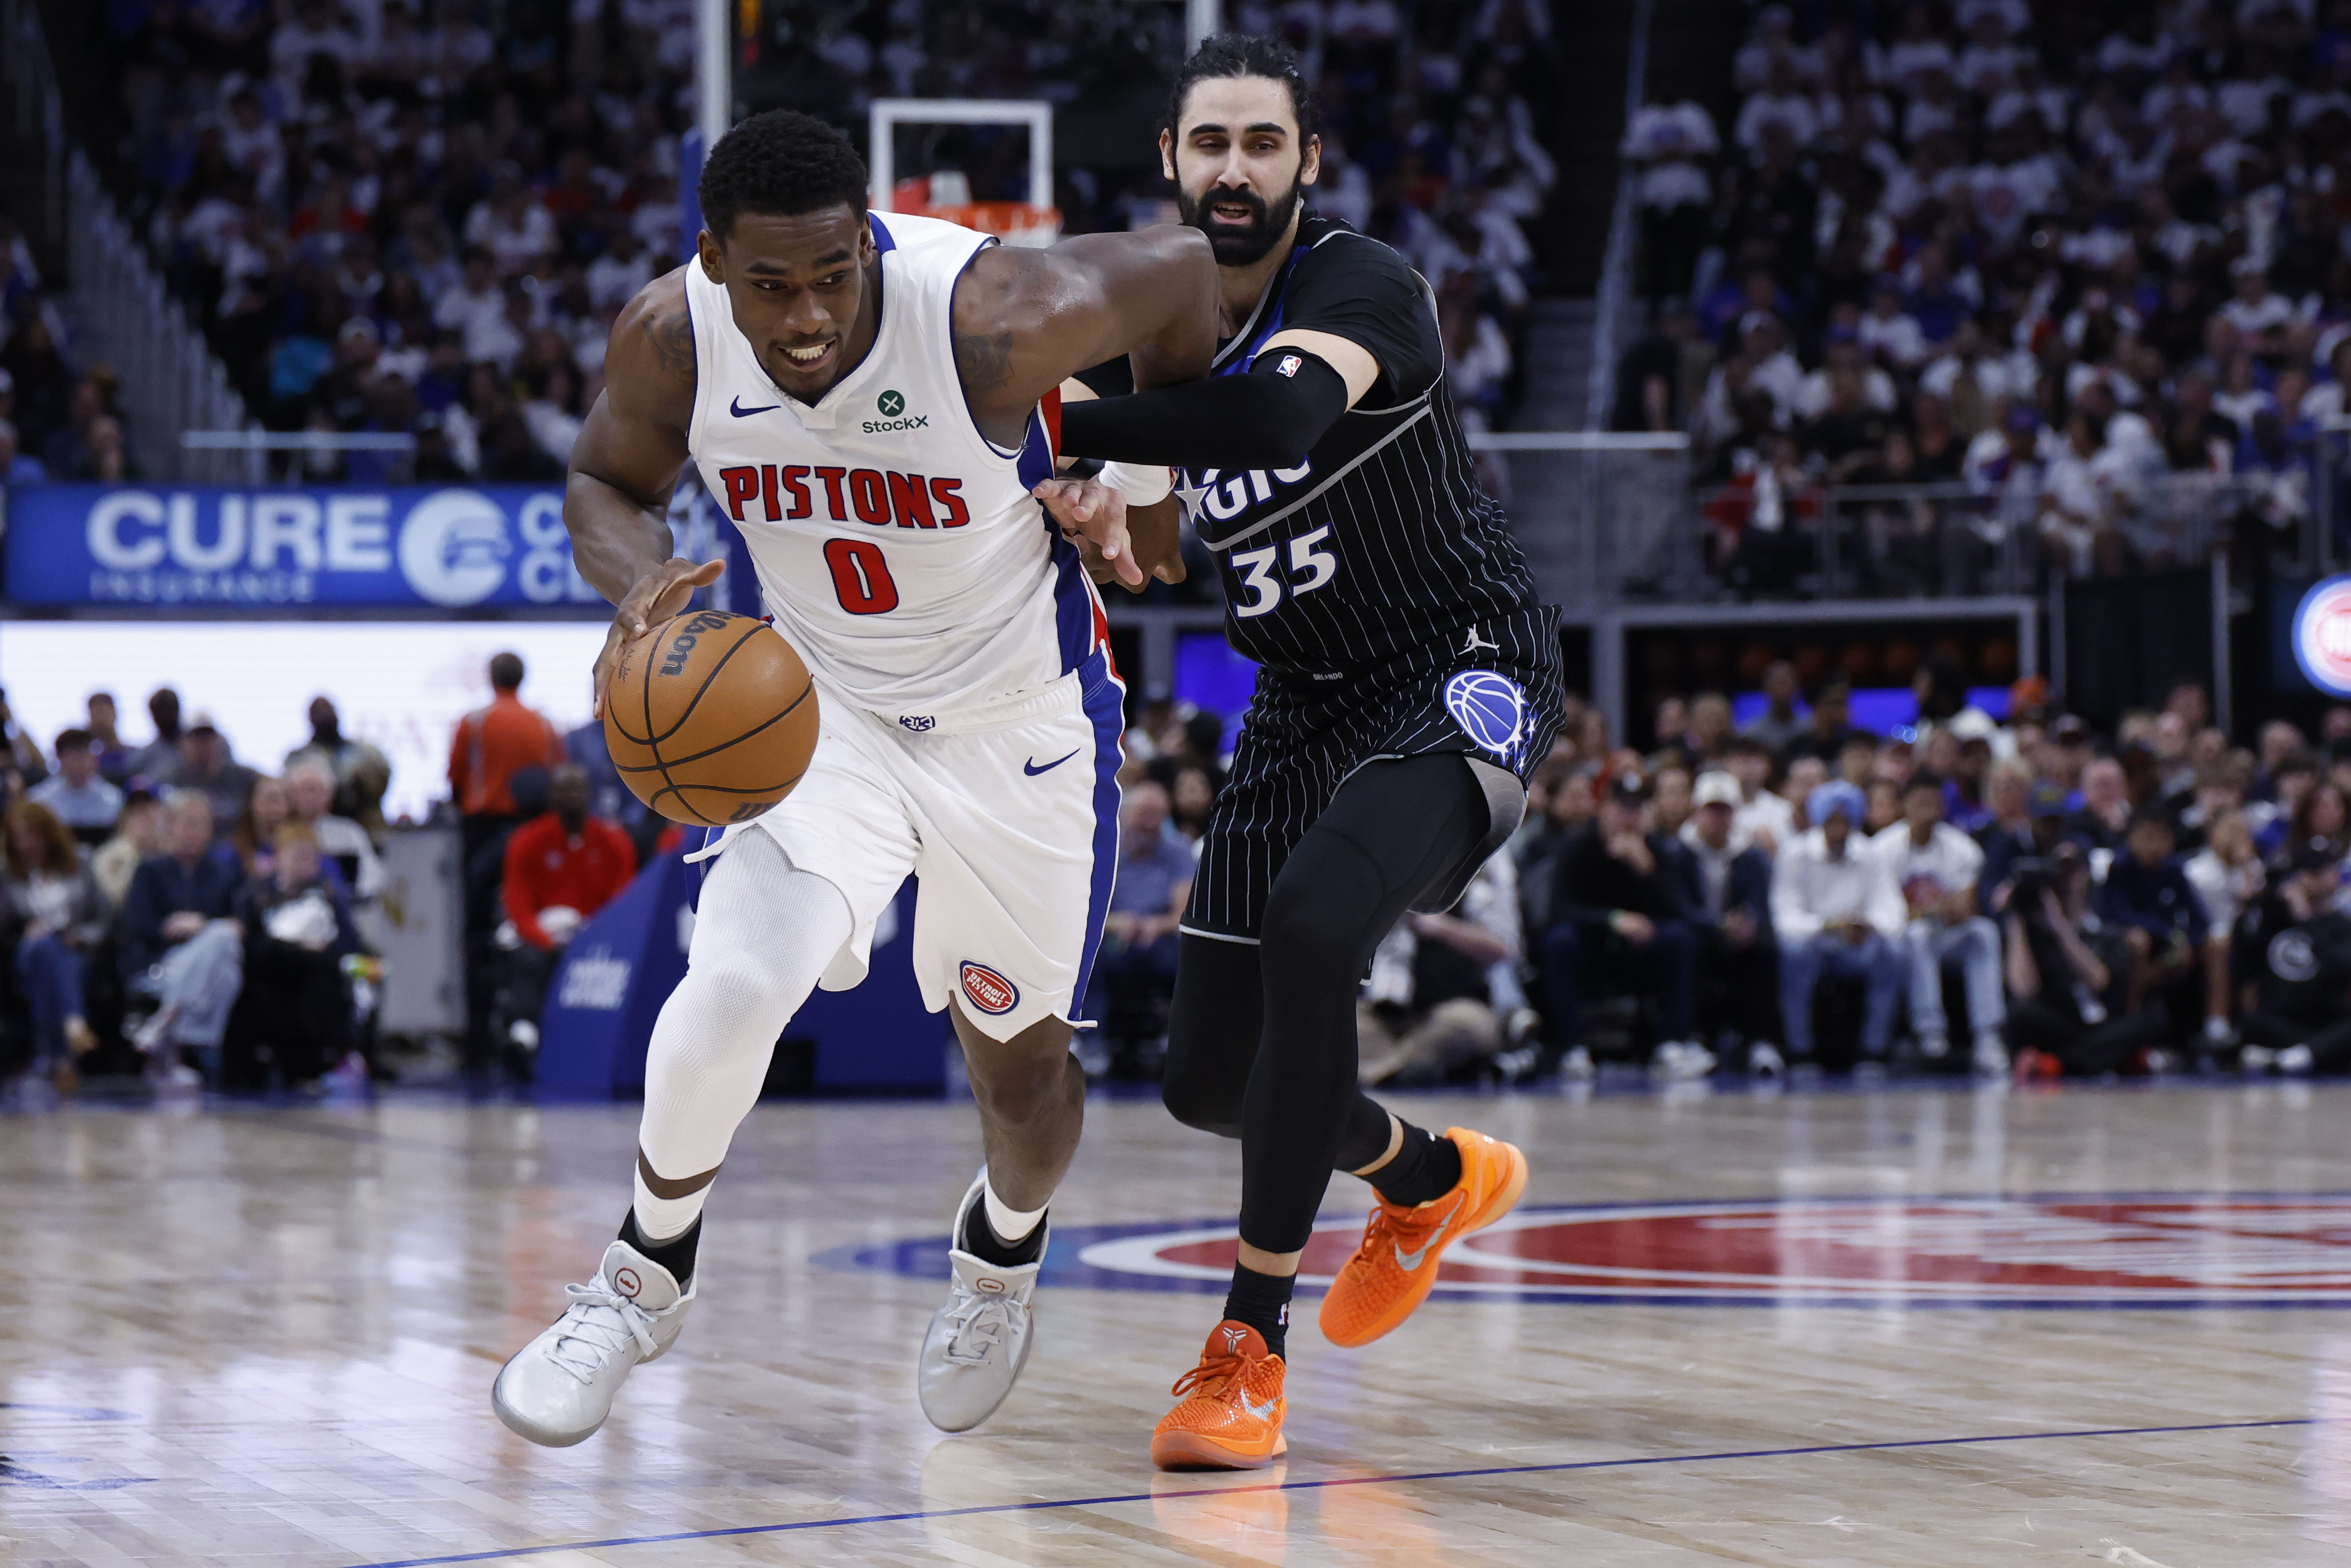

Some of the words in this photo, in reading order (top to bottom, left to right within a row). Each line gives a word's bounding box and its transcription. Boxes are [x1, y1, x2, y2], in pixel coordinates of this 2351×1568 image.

[862, 415, 929, 434] StockX
[719, 464, 971, 529] PISTONS
[86, 489, 392, 573] CURE
[90, 572, 315, 602] INSURANCE
[823, 538, 899, 615] 0
[1228, 521, 1340, 620] 35
[966, 975, 1003, 1006] PISTONS
[970, 971, 1007, 1000] DETROIT
